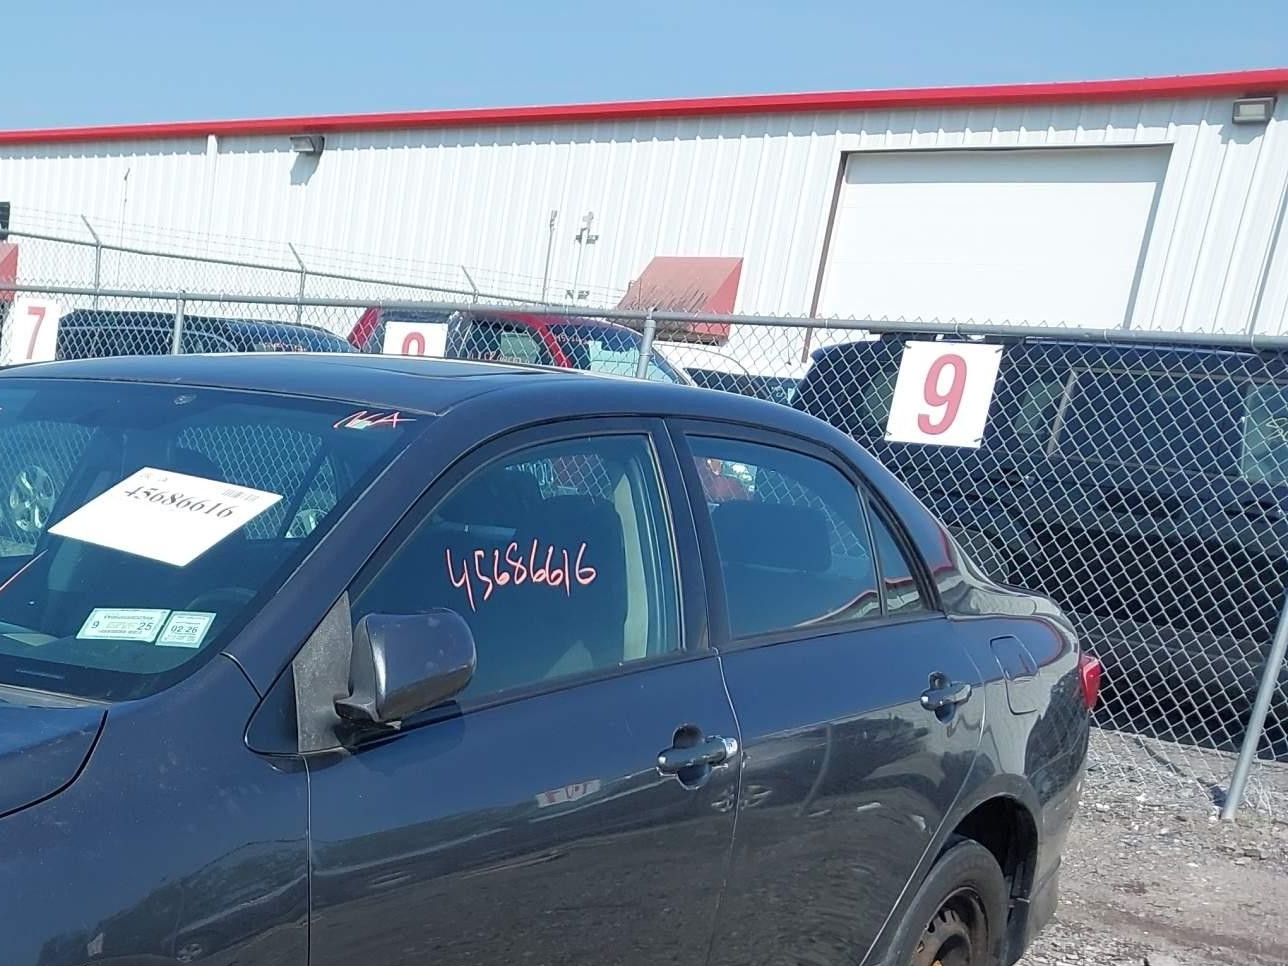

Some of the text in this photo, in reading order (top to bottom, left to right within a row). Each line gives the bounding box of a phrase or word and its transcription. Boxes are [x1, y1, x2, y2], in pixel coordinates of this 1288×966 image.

[25, 306, 46, 360] 7
[917, 353, 968, 436] 9
[124, 485, 241, 519] 45686616
[446, 538, 598, 613] 45686616
[90, 620, 154, 631] 9 25
